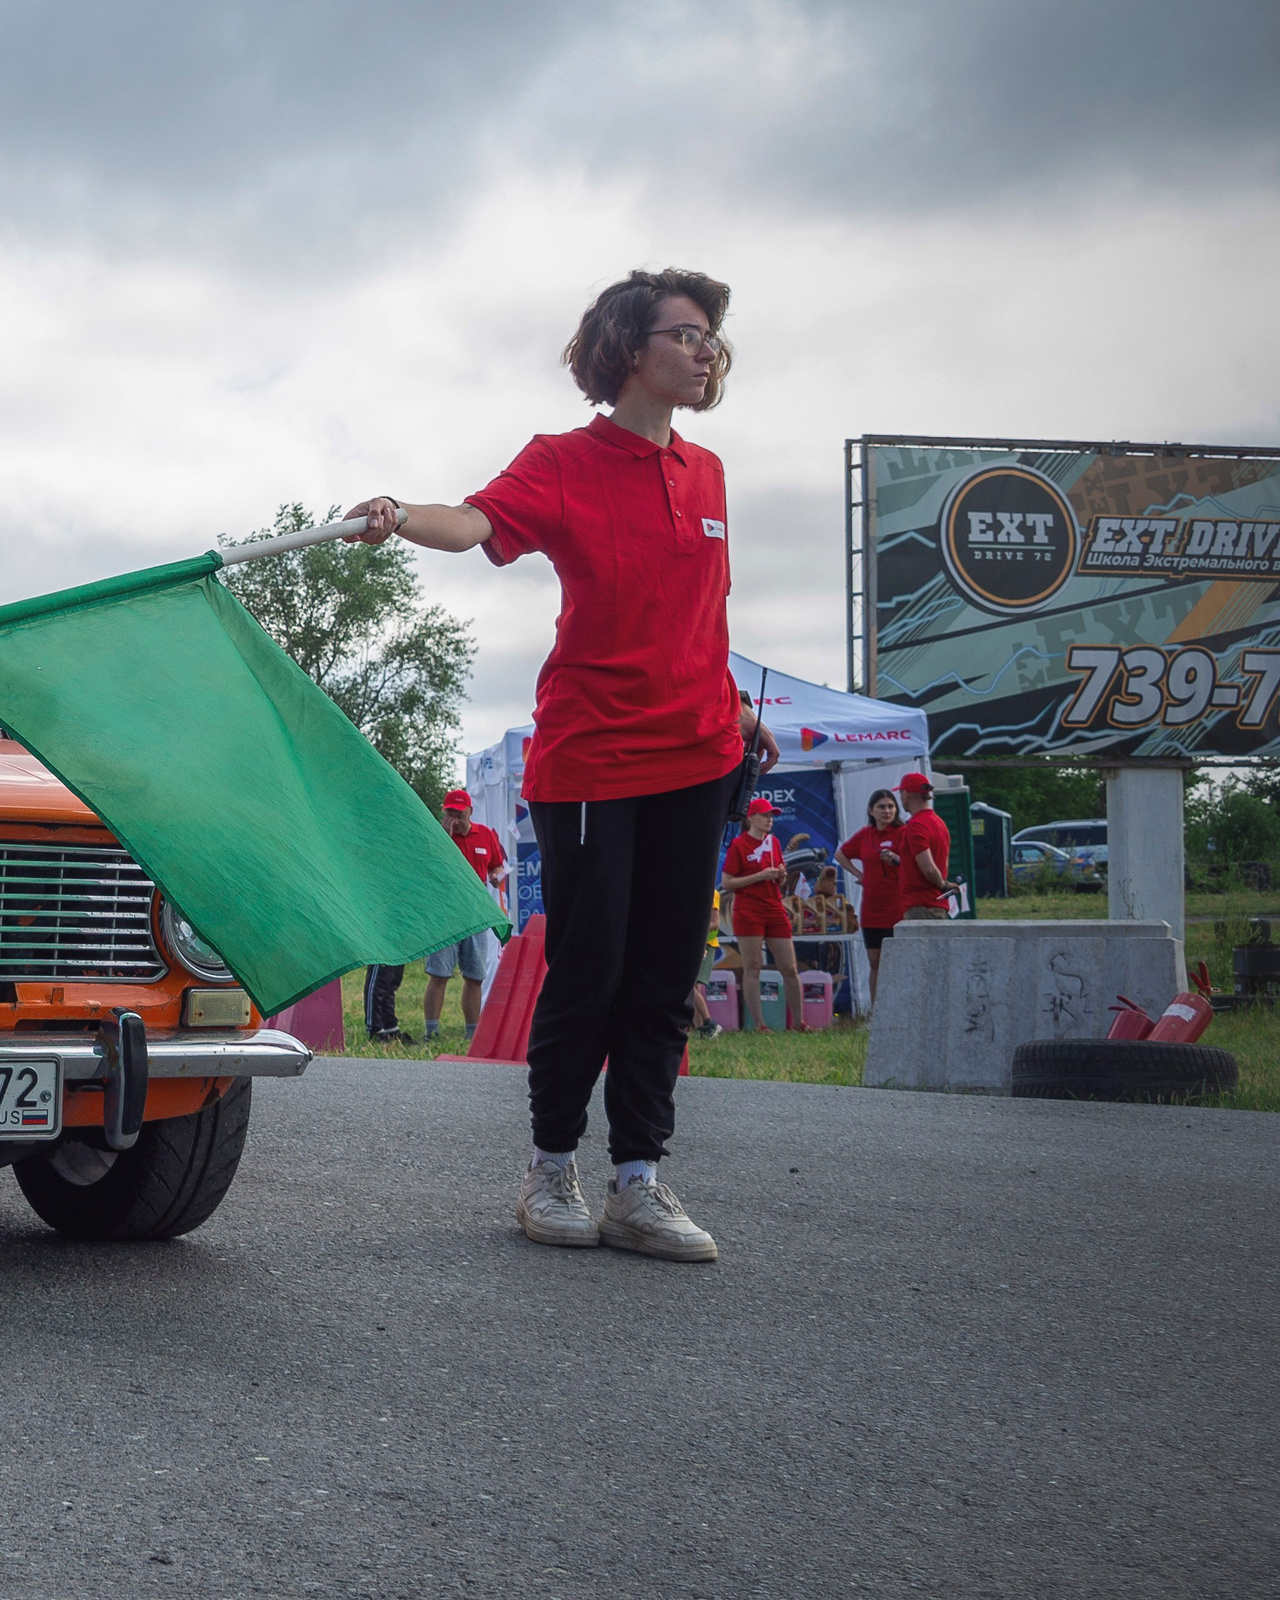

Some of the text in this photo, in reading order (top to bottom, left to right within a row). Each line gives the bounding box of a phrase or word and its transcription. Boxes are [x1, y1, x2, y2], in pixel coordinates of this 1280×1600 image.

[967, 511, 1054, 544] EXT
[1091, 518, 1178, 554] EXT
[974, 551, 1052, 562] DRIVE 72
[1086, 553, 1139, 566] Школа
[1143, 554, 1269, 571] Экстремального
[1064, 647, 1280, 726] 739-7
[834, 730, 911, 742] LEMARC
